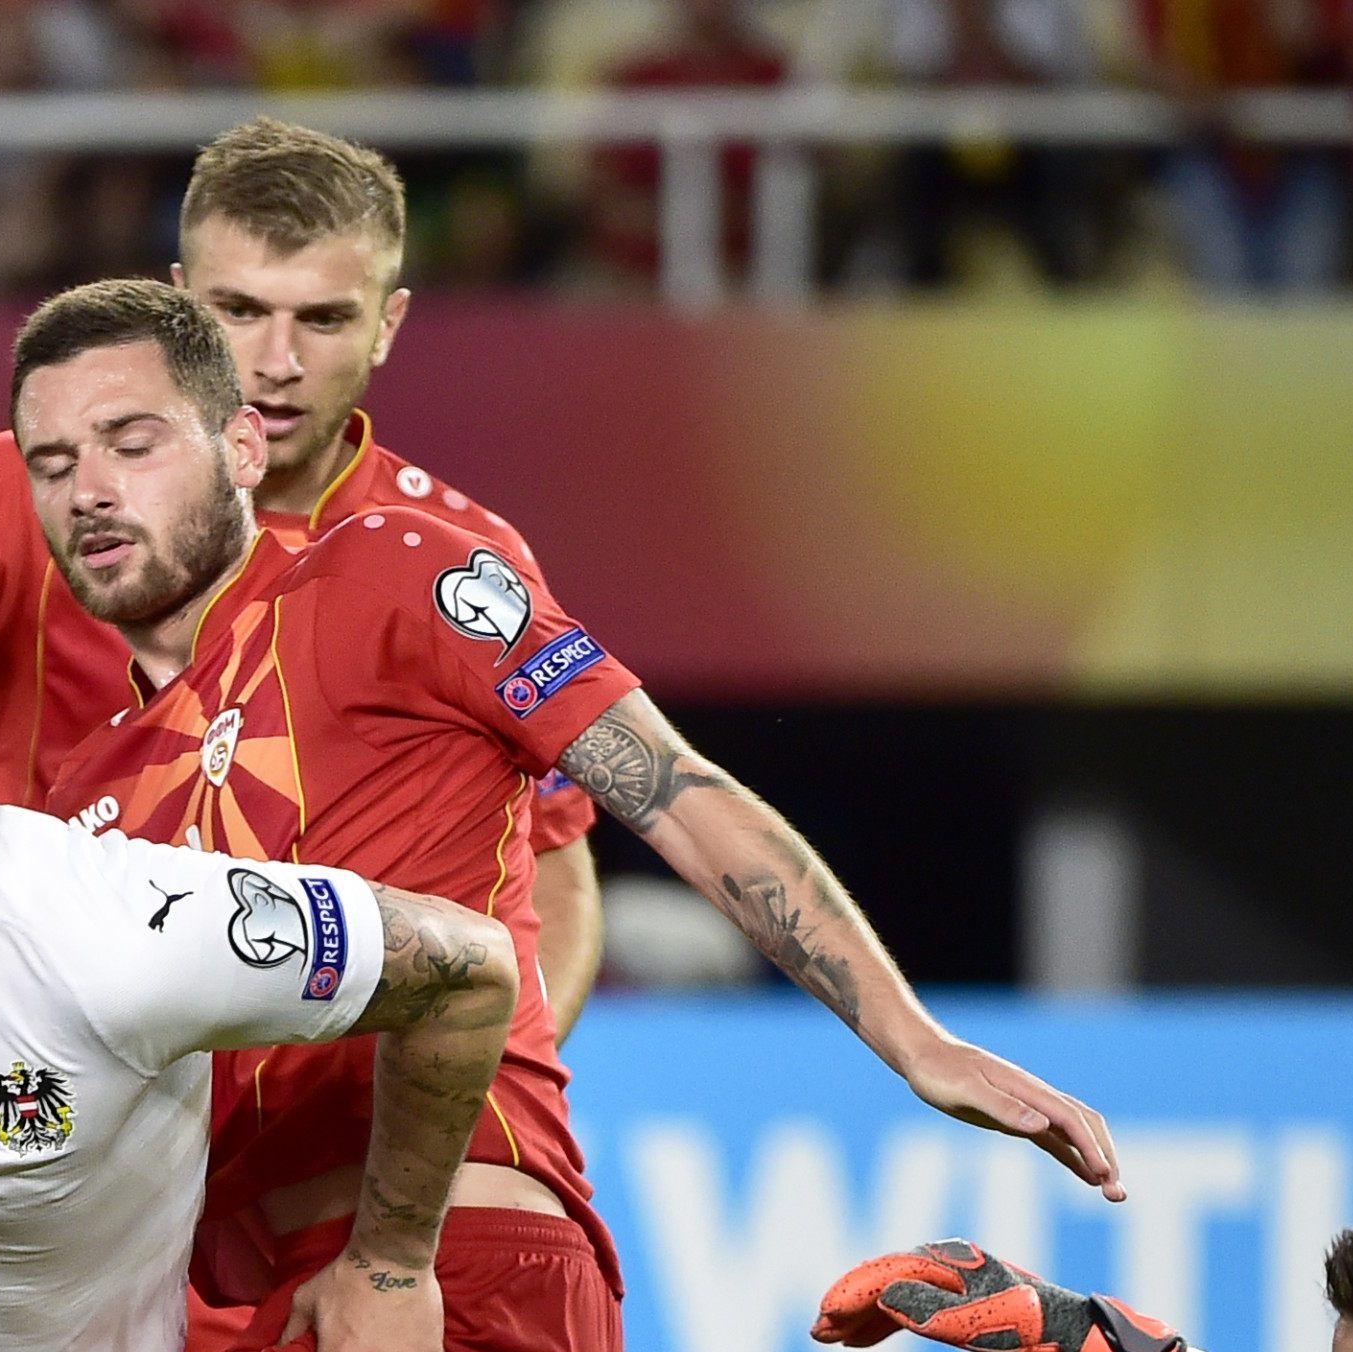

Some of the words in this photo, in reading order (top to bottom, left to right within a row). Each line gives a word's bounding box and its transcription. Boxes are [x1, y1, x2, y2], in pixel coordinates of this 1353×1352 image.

[531, 635, 596, 687] RESPECT
[305, 879, 339, 963] RESPECT
[369, 1270, 418, 1292] Love
